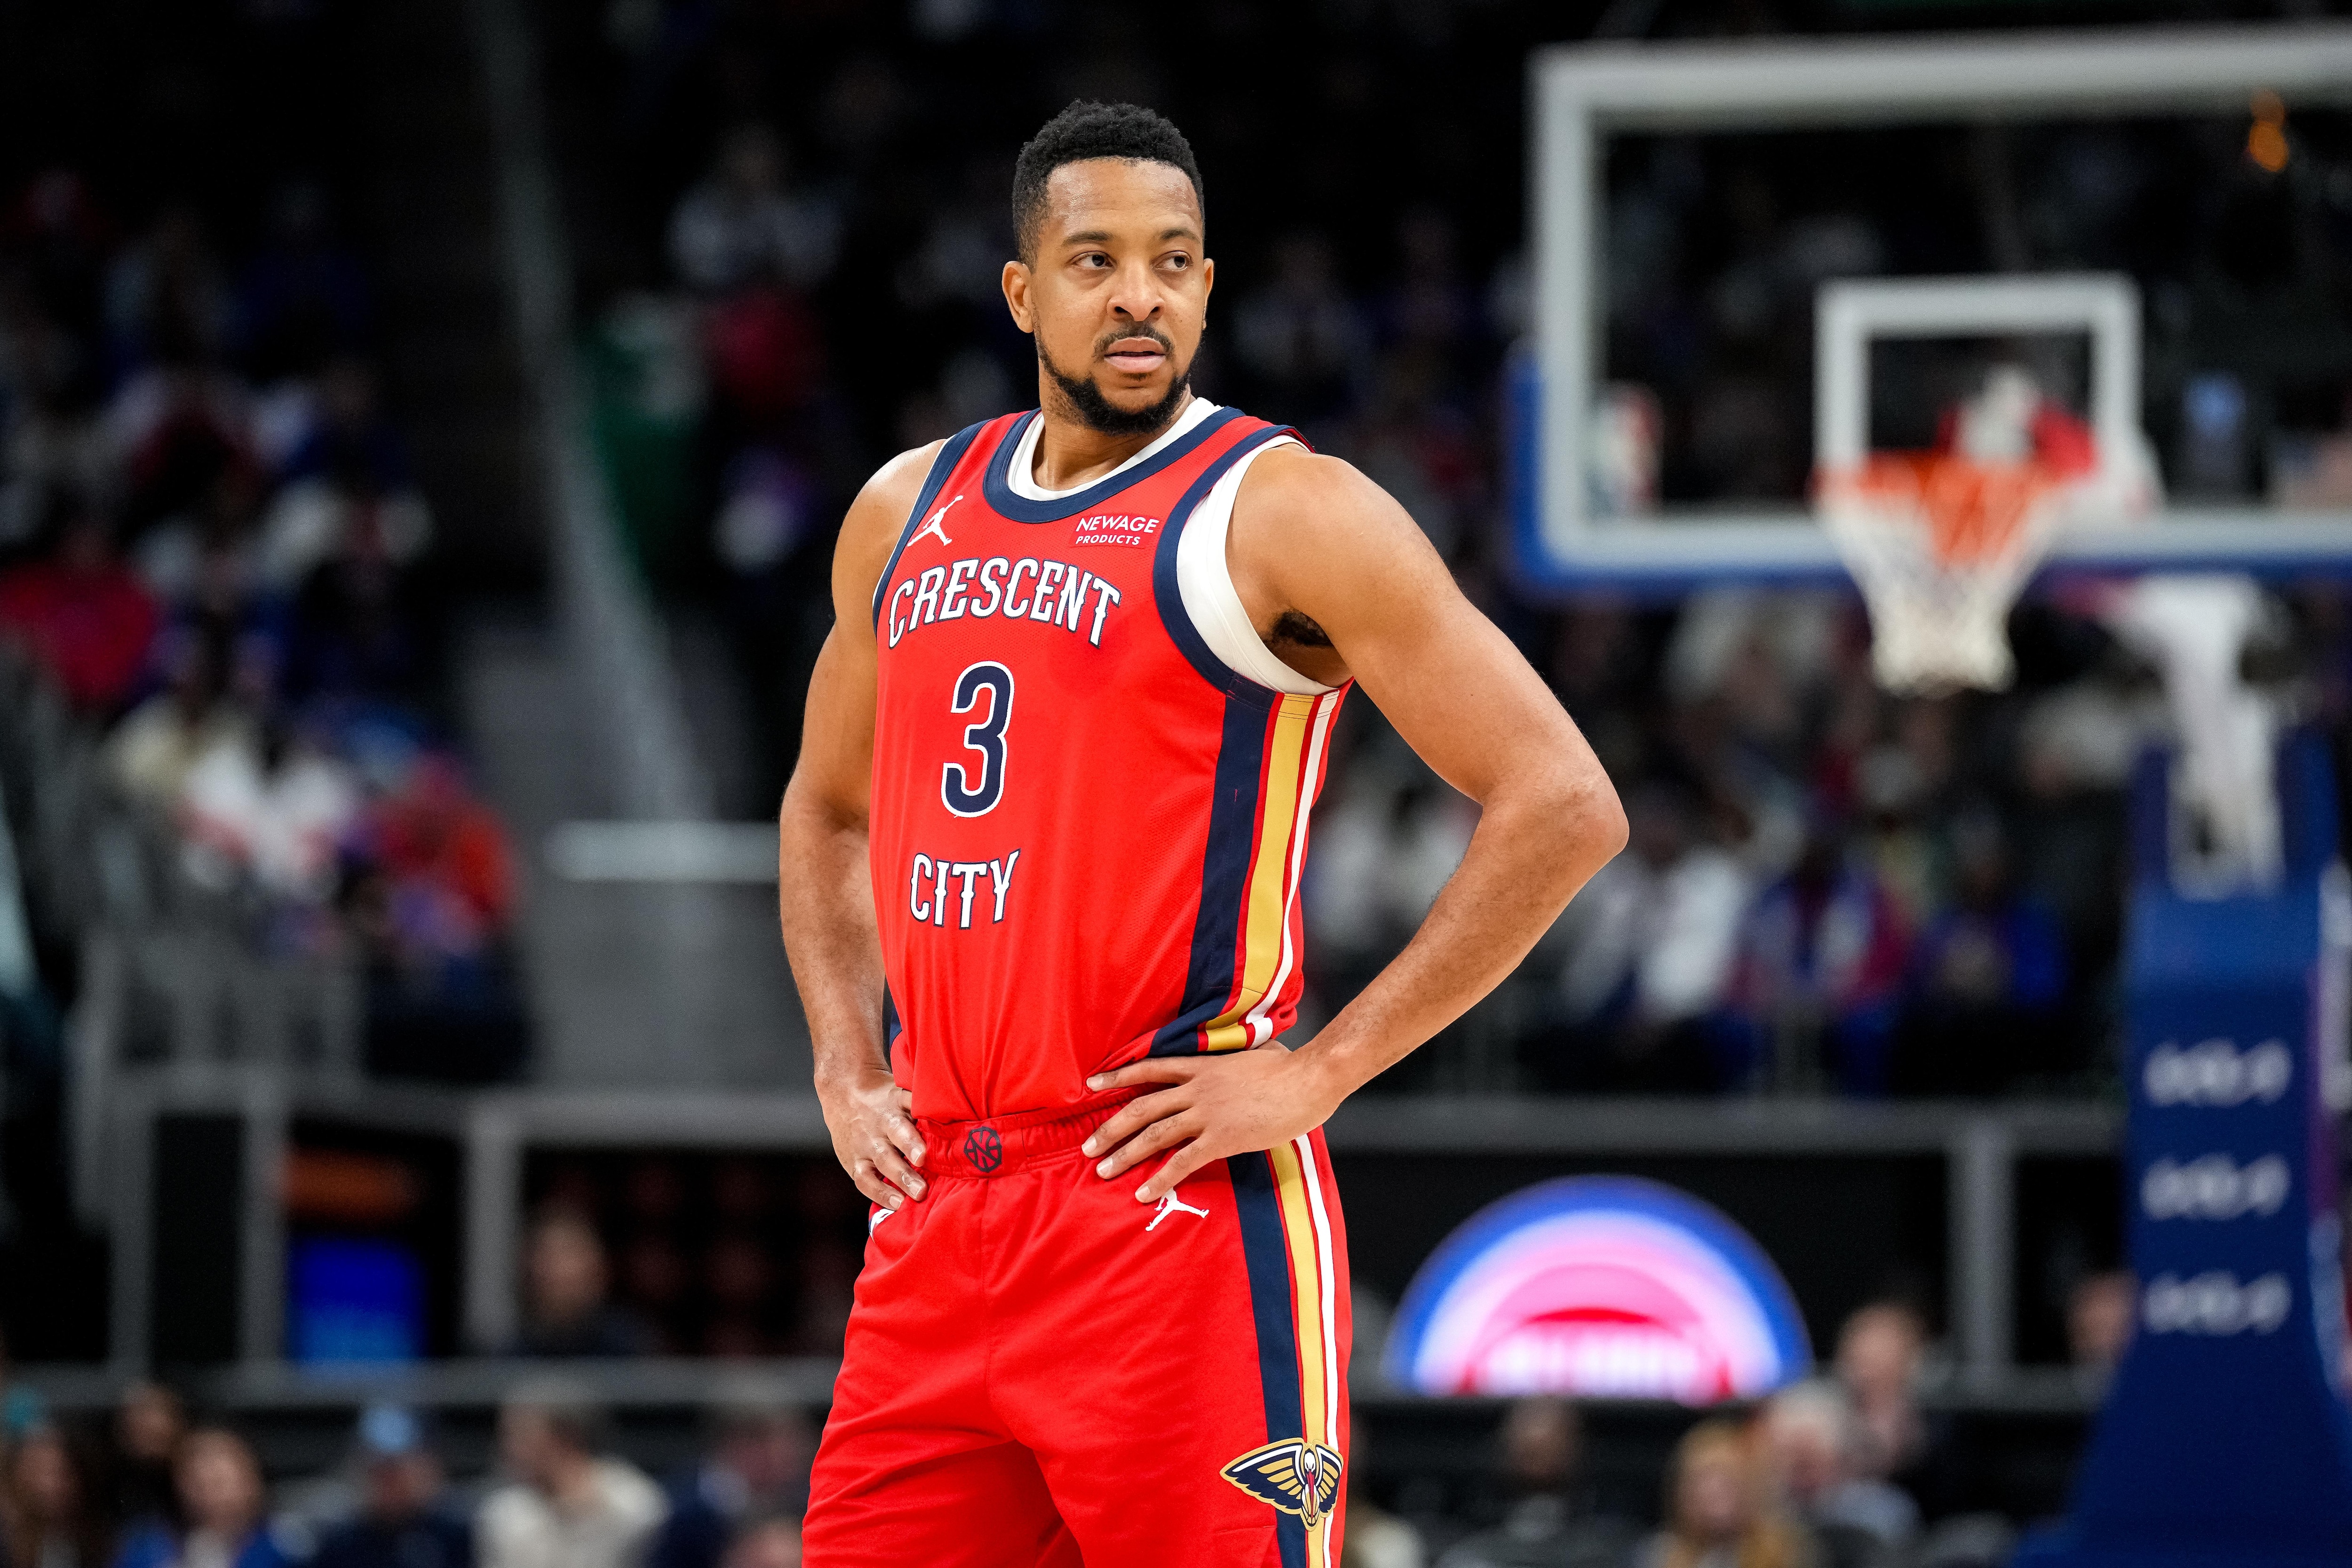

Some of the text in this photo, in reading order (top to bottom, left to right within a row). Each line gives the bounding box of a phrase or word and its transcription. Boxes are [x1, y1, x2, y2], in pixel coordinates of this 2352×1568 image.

[1075, 515, 1160, 533] NEWAGE
[1075, 534, 1141, 545] PRODUCTS
[888, 557, 1121, 649] CRESCENT
[941, 660, 1015, 818] 3
[910, 849, 1021, 930] CITY
